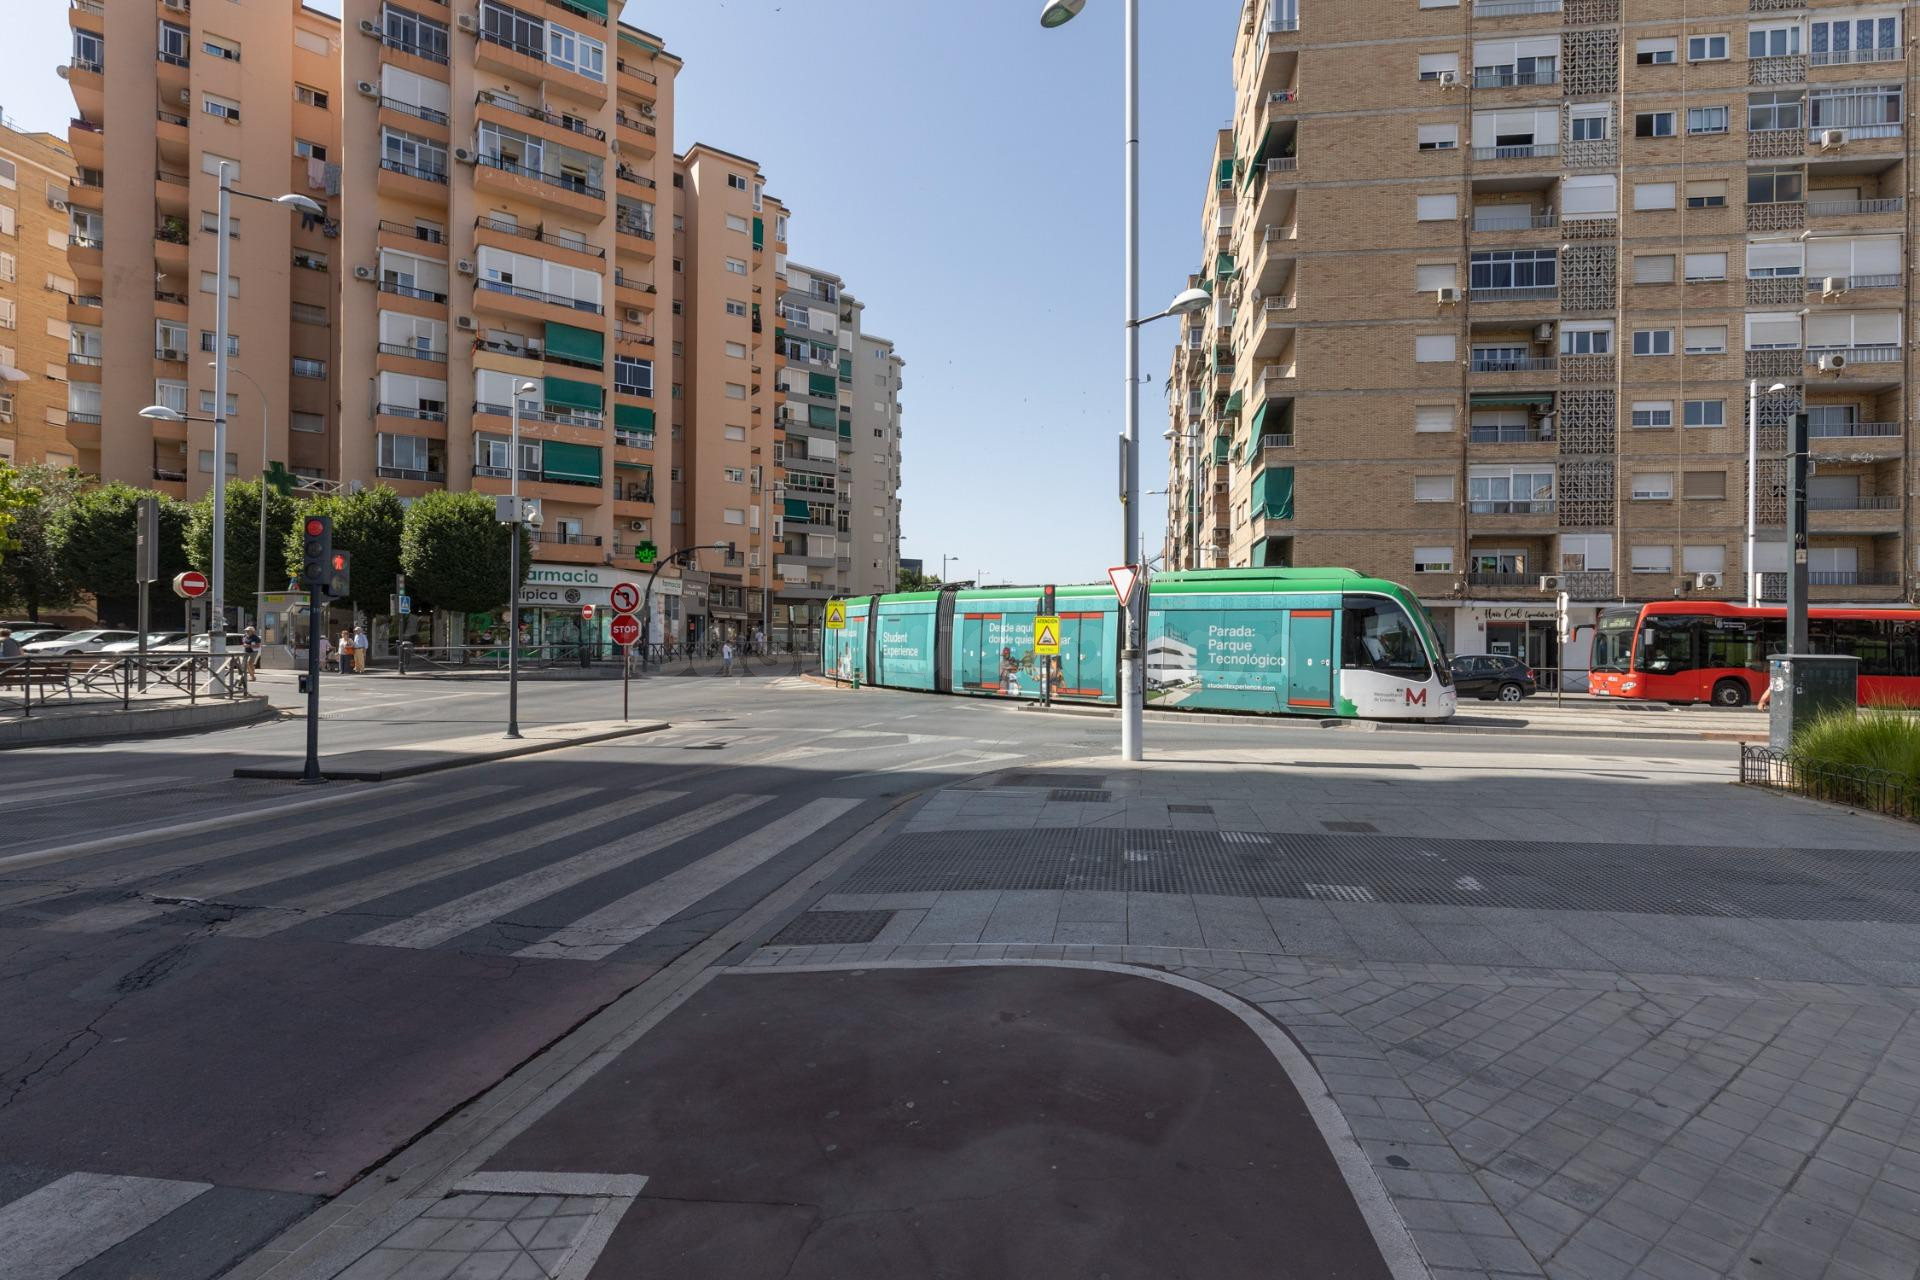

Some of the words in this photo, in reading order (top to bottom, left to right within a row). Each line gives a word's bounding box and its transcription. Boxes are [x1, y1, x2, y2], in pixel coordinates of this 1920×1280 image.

[527, 569, 598, 583] armacia
[518, 587, 558, 602] ípica
[613, 625, 638, 633] STOP
[989, 623, 1014, 633] Desde
[1208, 625, 1256, 637] Parada:
[883, 632, 908, 643] Student
[883, 645, 919, 657] Experience
[1208, 639, 1252, 653] Parque
[1208, 653, 1287, 668] Tecnológico
[1406, 687, 1427, 705] M
